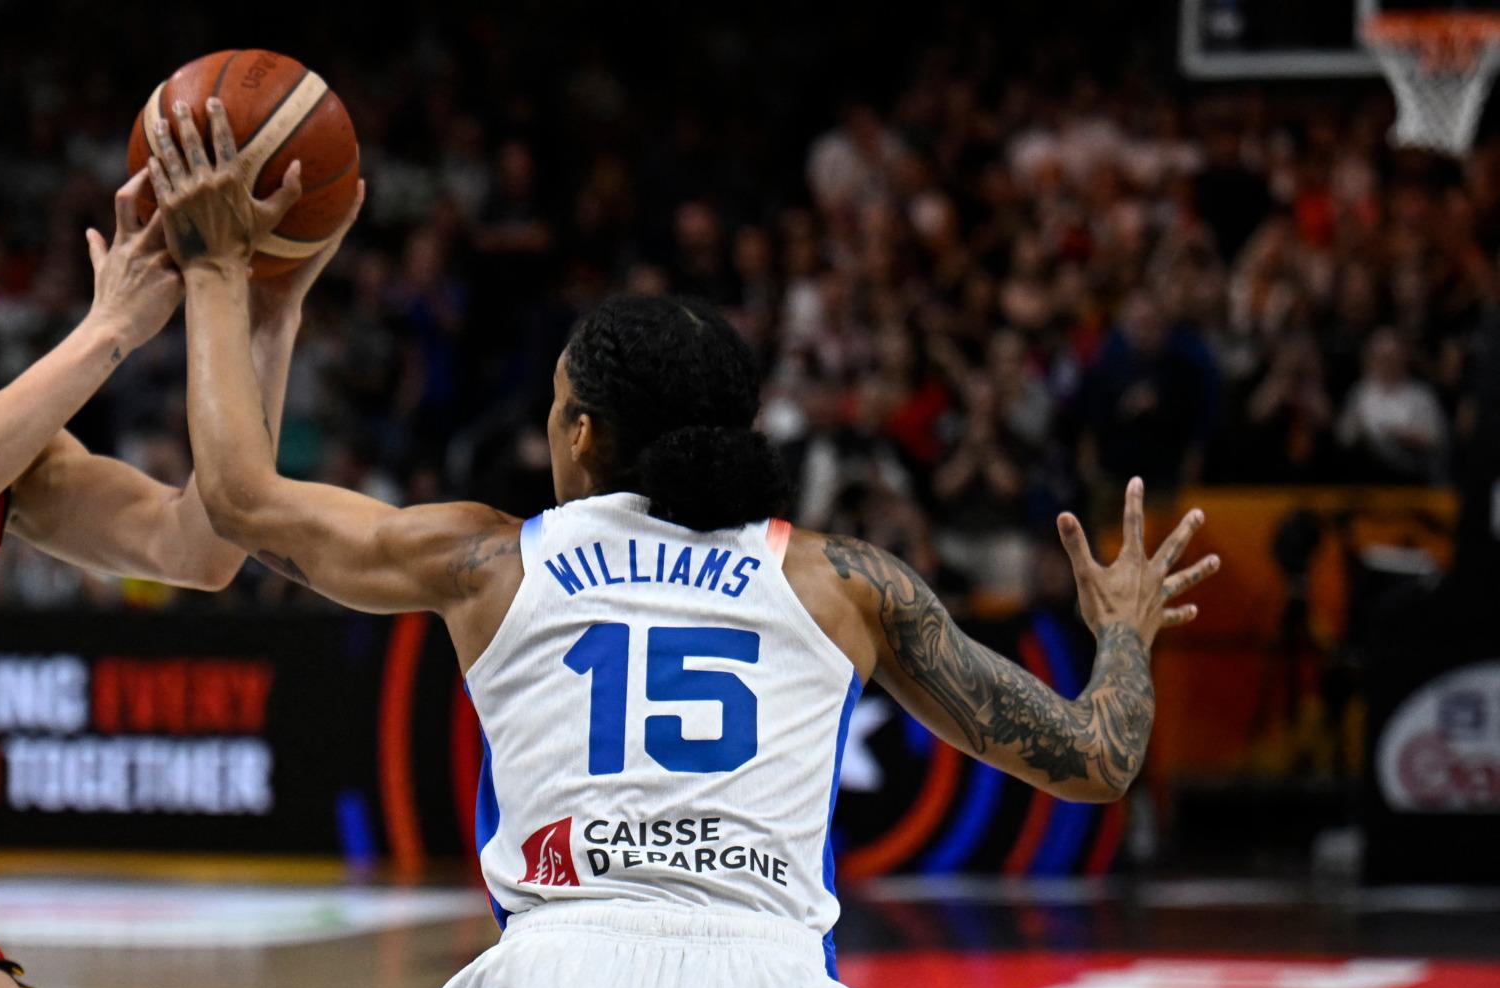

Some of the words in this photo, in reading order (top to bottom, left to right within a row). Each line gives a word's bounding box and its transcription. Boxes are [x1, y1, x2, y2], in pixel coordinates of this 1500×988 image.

[543, 539, 761, 598] WILLIAMS
[563, 622, 760, 776] 15
[583, 817, 721, 847] CAISSE
